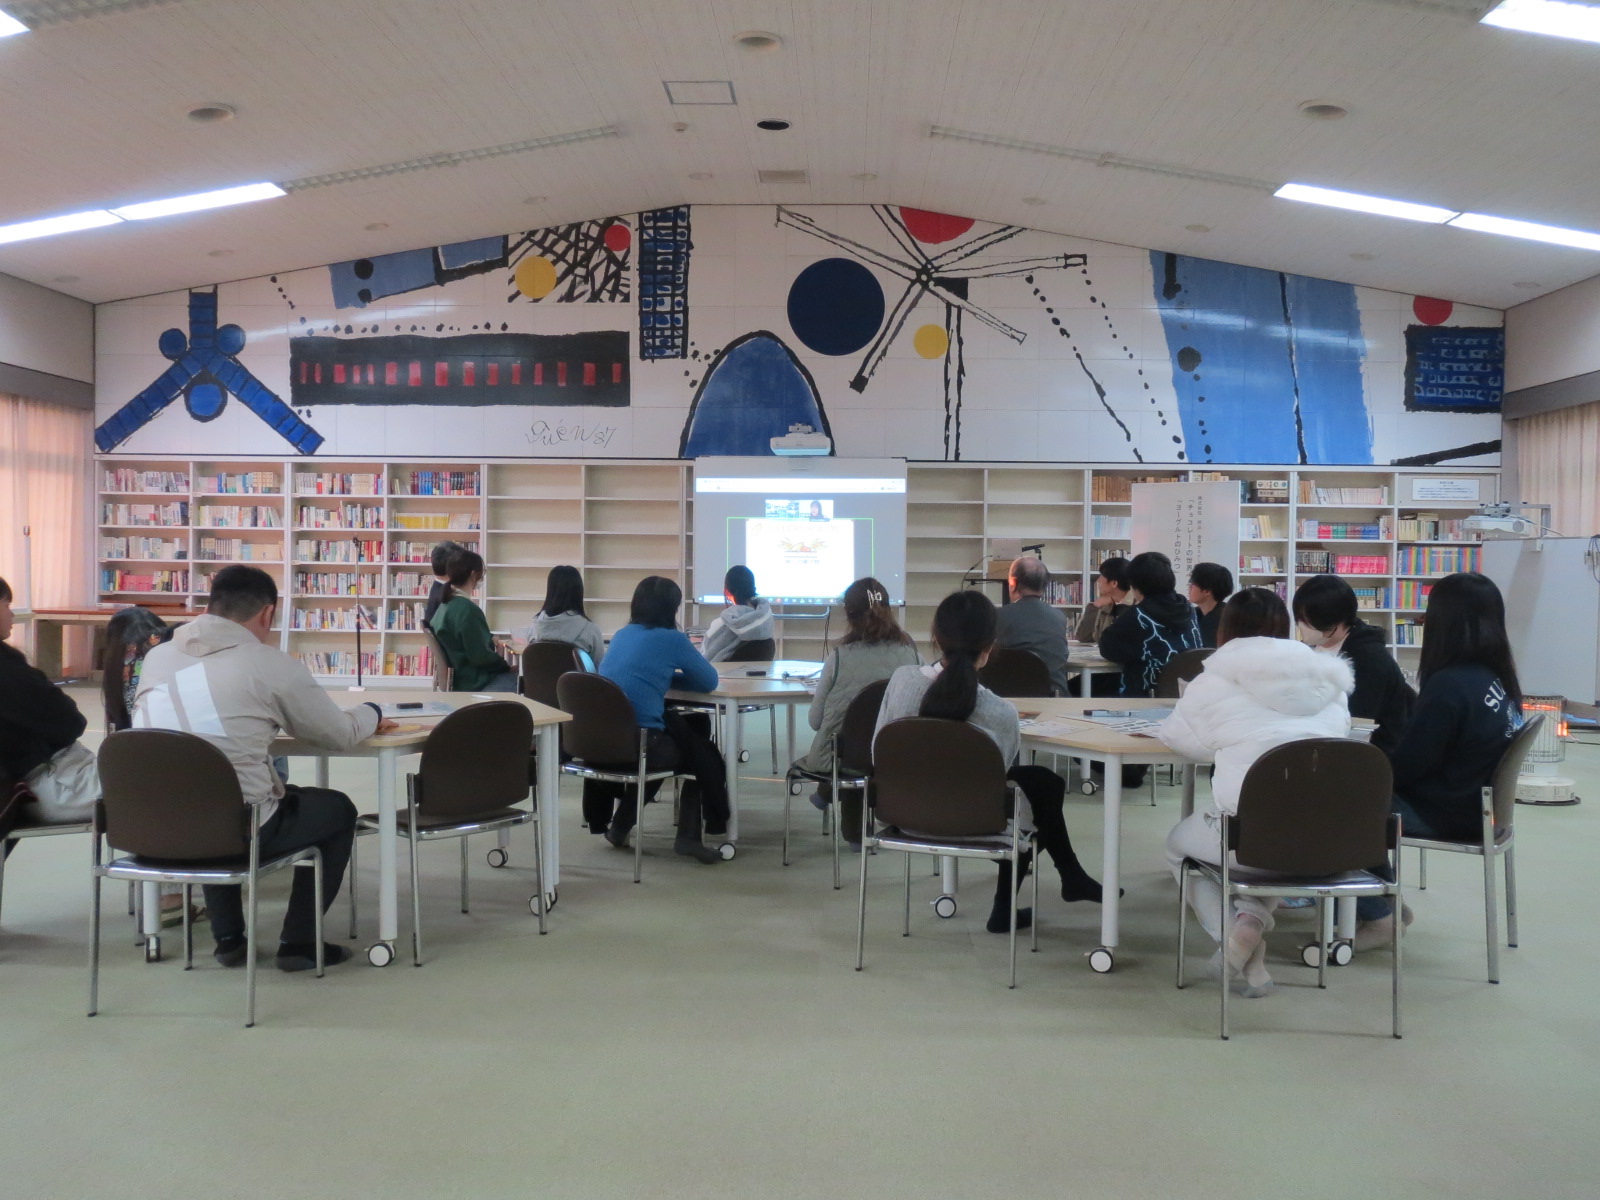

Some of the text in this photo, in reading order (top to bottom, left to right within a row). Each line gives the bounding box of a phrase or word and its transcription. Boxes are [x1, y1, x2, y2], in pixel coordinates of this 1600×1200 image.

[1173, 499, 1183, 574] 「ヨーグルトのひみつ」
